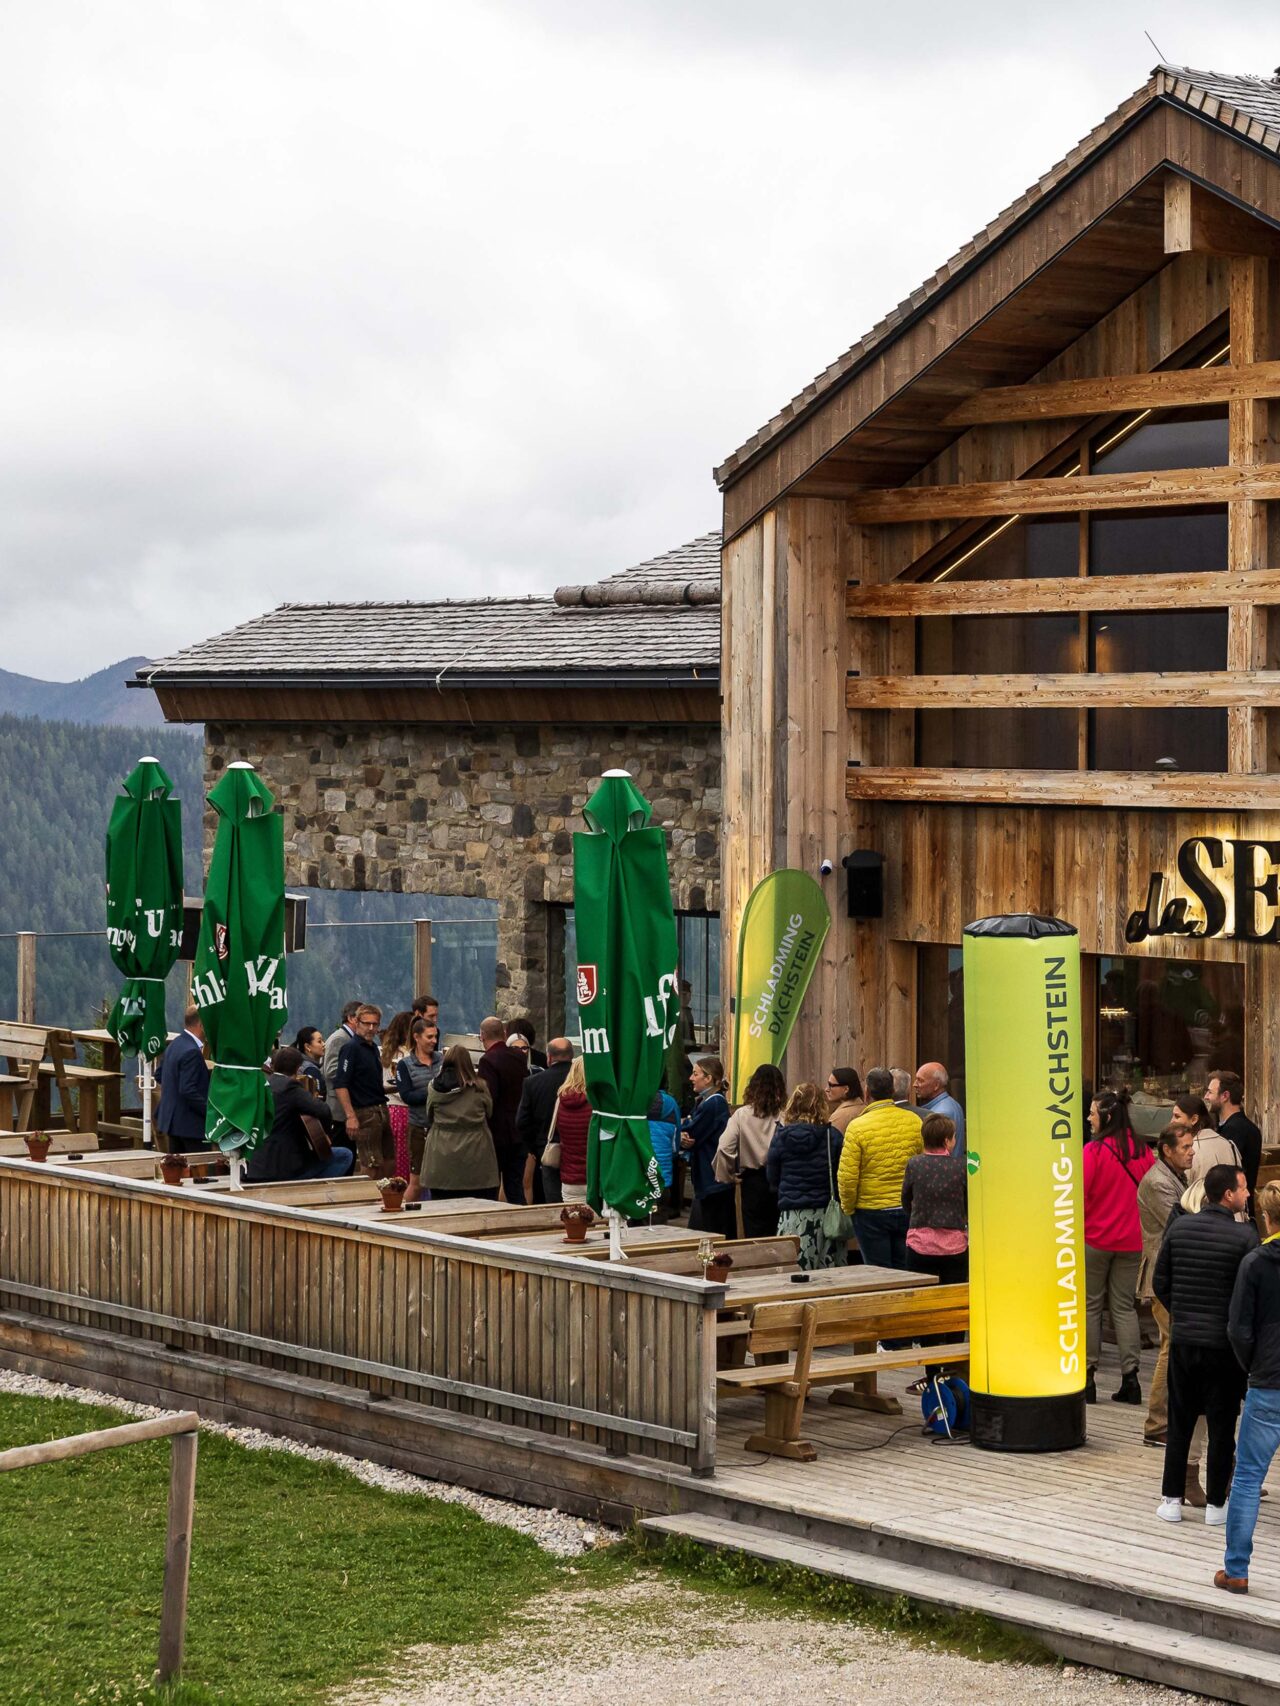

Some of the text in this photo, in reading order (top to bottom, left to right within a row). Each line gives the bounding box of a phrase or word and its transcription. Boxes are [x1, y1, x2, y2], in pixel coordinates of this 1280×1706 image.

[1125, 872, 1203, 944] da
[749, 913, 803, 1039] SCHLADMING
[768, 930, 816, 1036] DACHSTEIN
[1044, 956, 1078, 1376] SCHLADMING-DACHSTEIN
